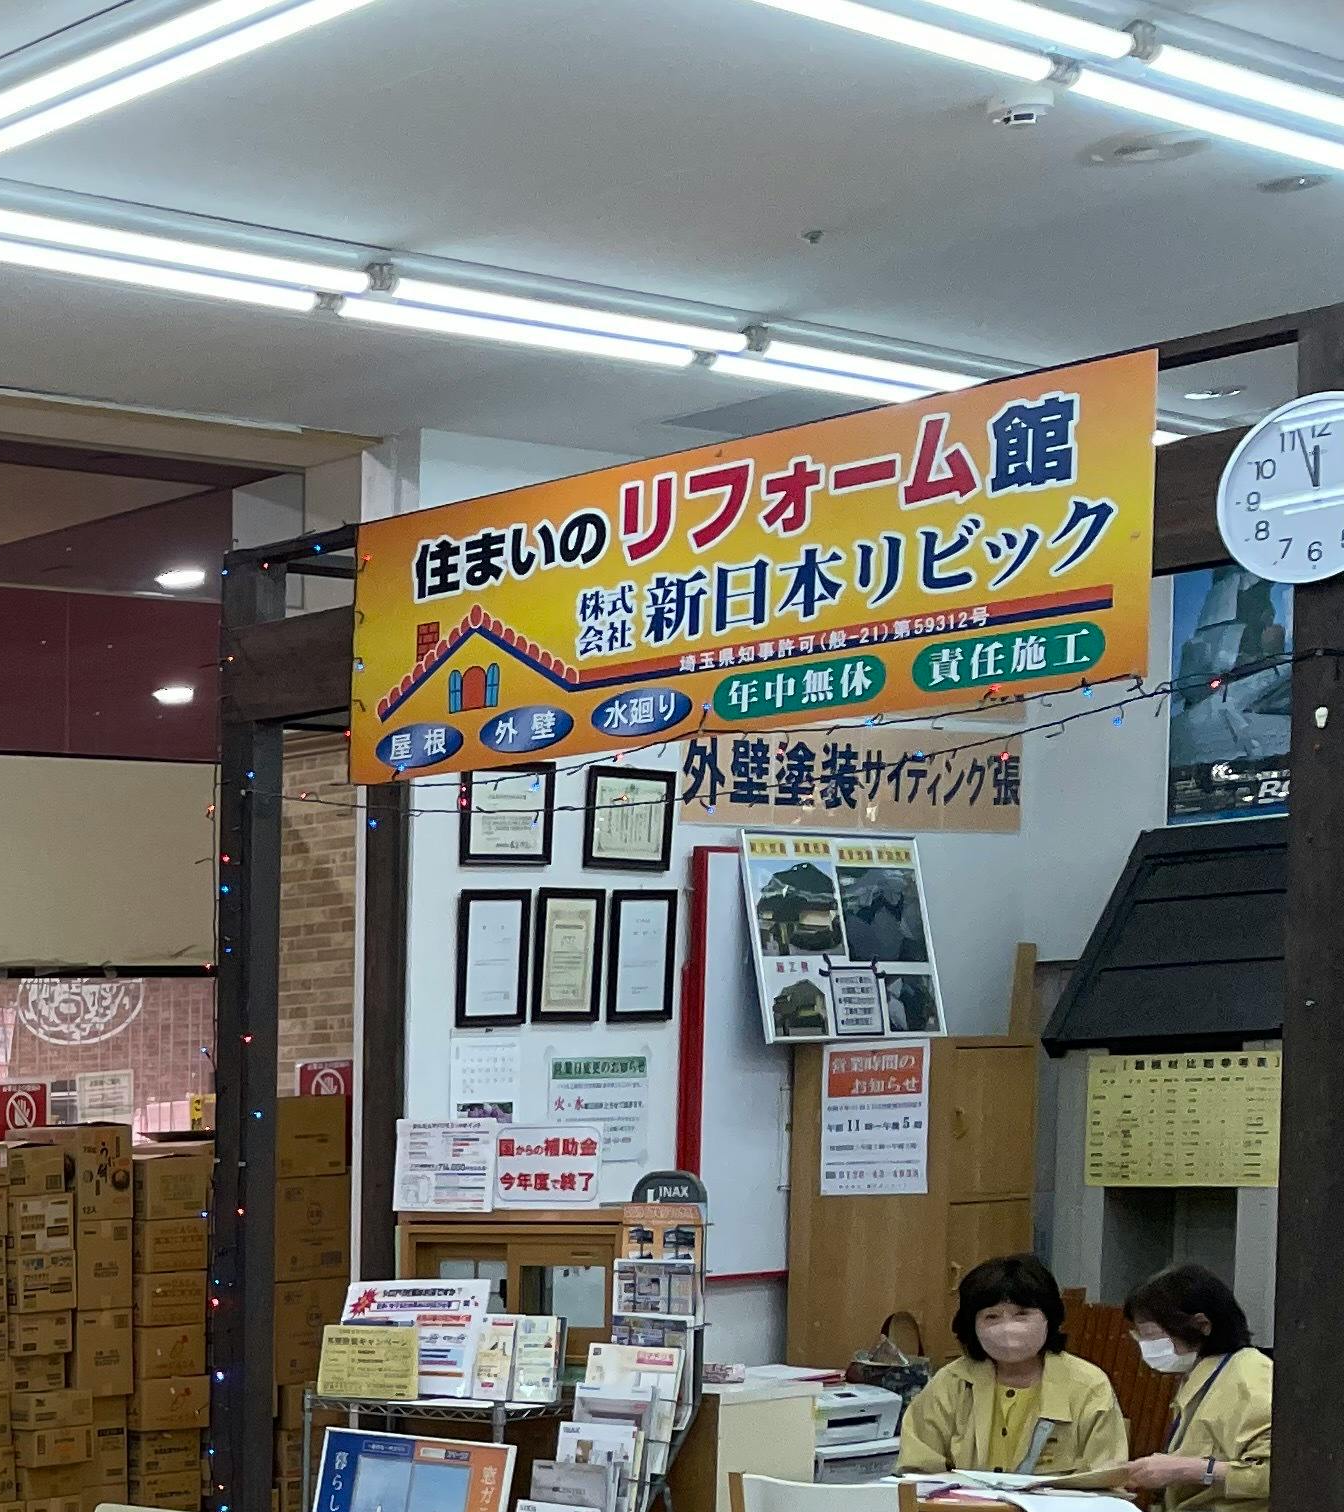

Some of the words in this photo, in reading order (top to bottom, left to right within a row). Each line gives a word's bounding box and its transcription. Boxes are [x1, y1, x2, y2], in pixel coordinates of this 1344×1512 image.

[1279, 429, 1297, 454] 11
[1254, 458, 1276, 481] 10
[415, 395, 1077, 600] 住まいのリフォーム館
[1246, 491, 1262, 512] 9
[1254, 520, 1270, 541] 8
[1279, 537, 1293, 560] 7
[1307, 541, 1323, 563] 6
[646, 499, 1115, 643] 新日本リビック
[580, 585, 634, 622] 株式
[579, 620, 632, 656] 会社
[930, 629, 1091, 685] 責任施工
[728, 660, 874, 714] 年中無休
[604, 693, 676, 729] 水廻り
[495, 711, 556, 745] 外壁
[390, 728, 448, 761] 屋根
[683, 738, 1021, 810] 外壁塗装サイディング張
[850, 1075, 919, 1094] お知らせ
[499, 1137, 598, 1158] 国からの補助金
[500, 1171, 595, 1192] 今年度で終了
[658, 1185, 689, 1199] INAX
